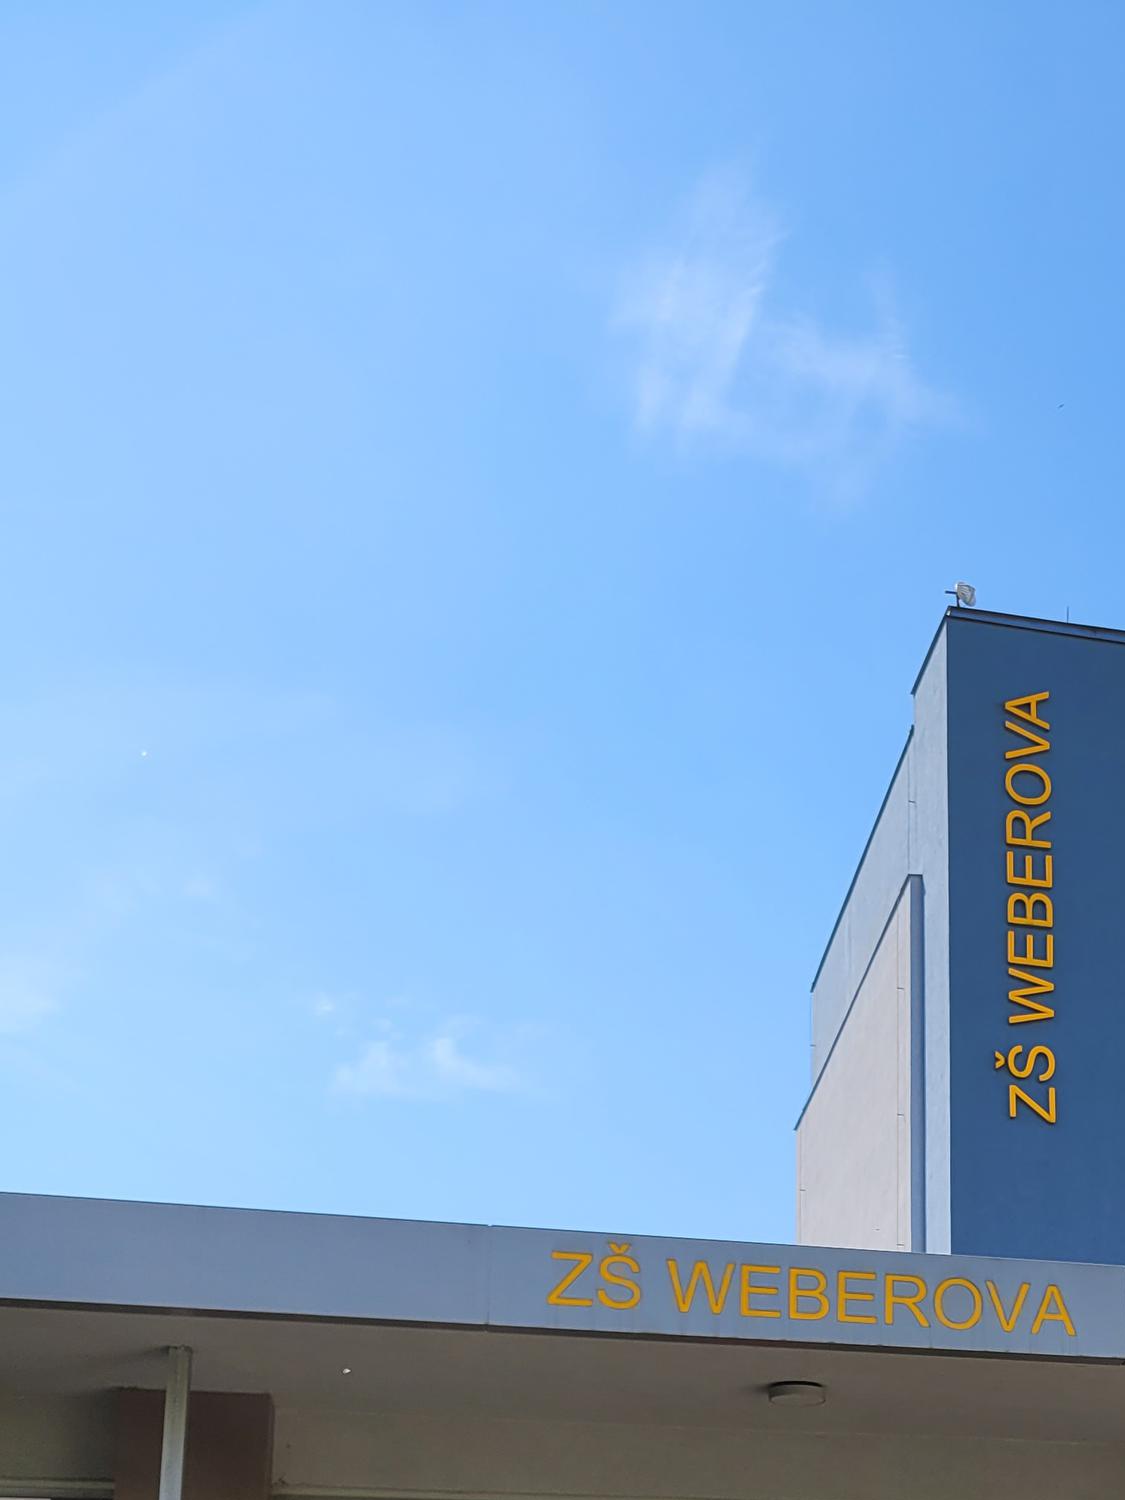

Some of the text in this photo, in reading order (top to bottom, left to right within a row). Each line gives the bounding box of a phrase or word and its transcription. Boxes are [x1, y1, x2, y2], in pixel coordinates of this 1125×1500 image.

[994, 690, 1058, 1125] ZŠ WEBEROVA
[546, 1242, 1078, 1337] ZŠ WEBEROVA
